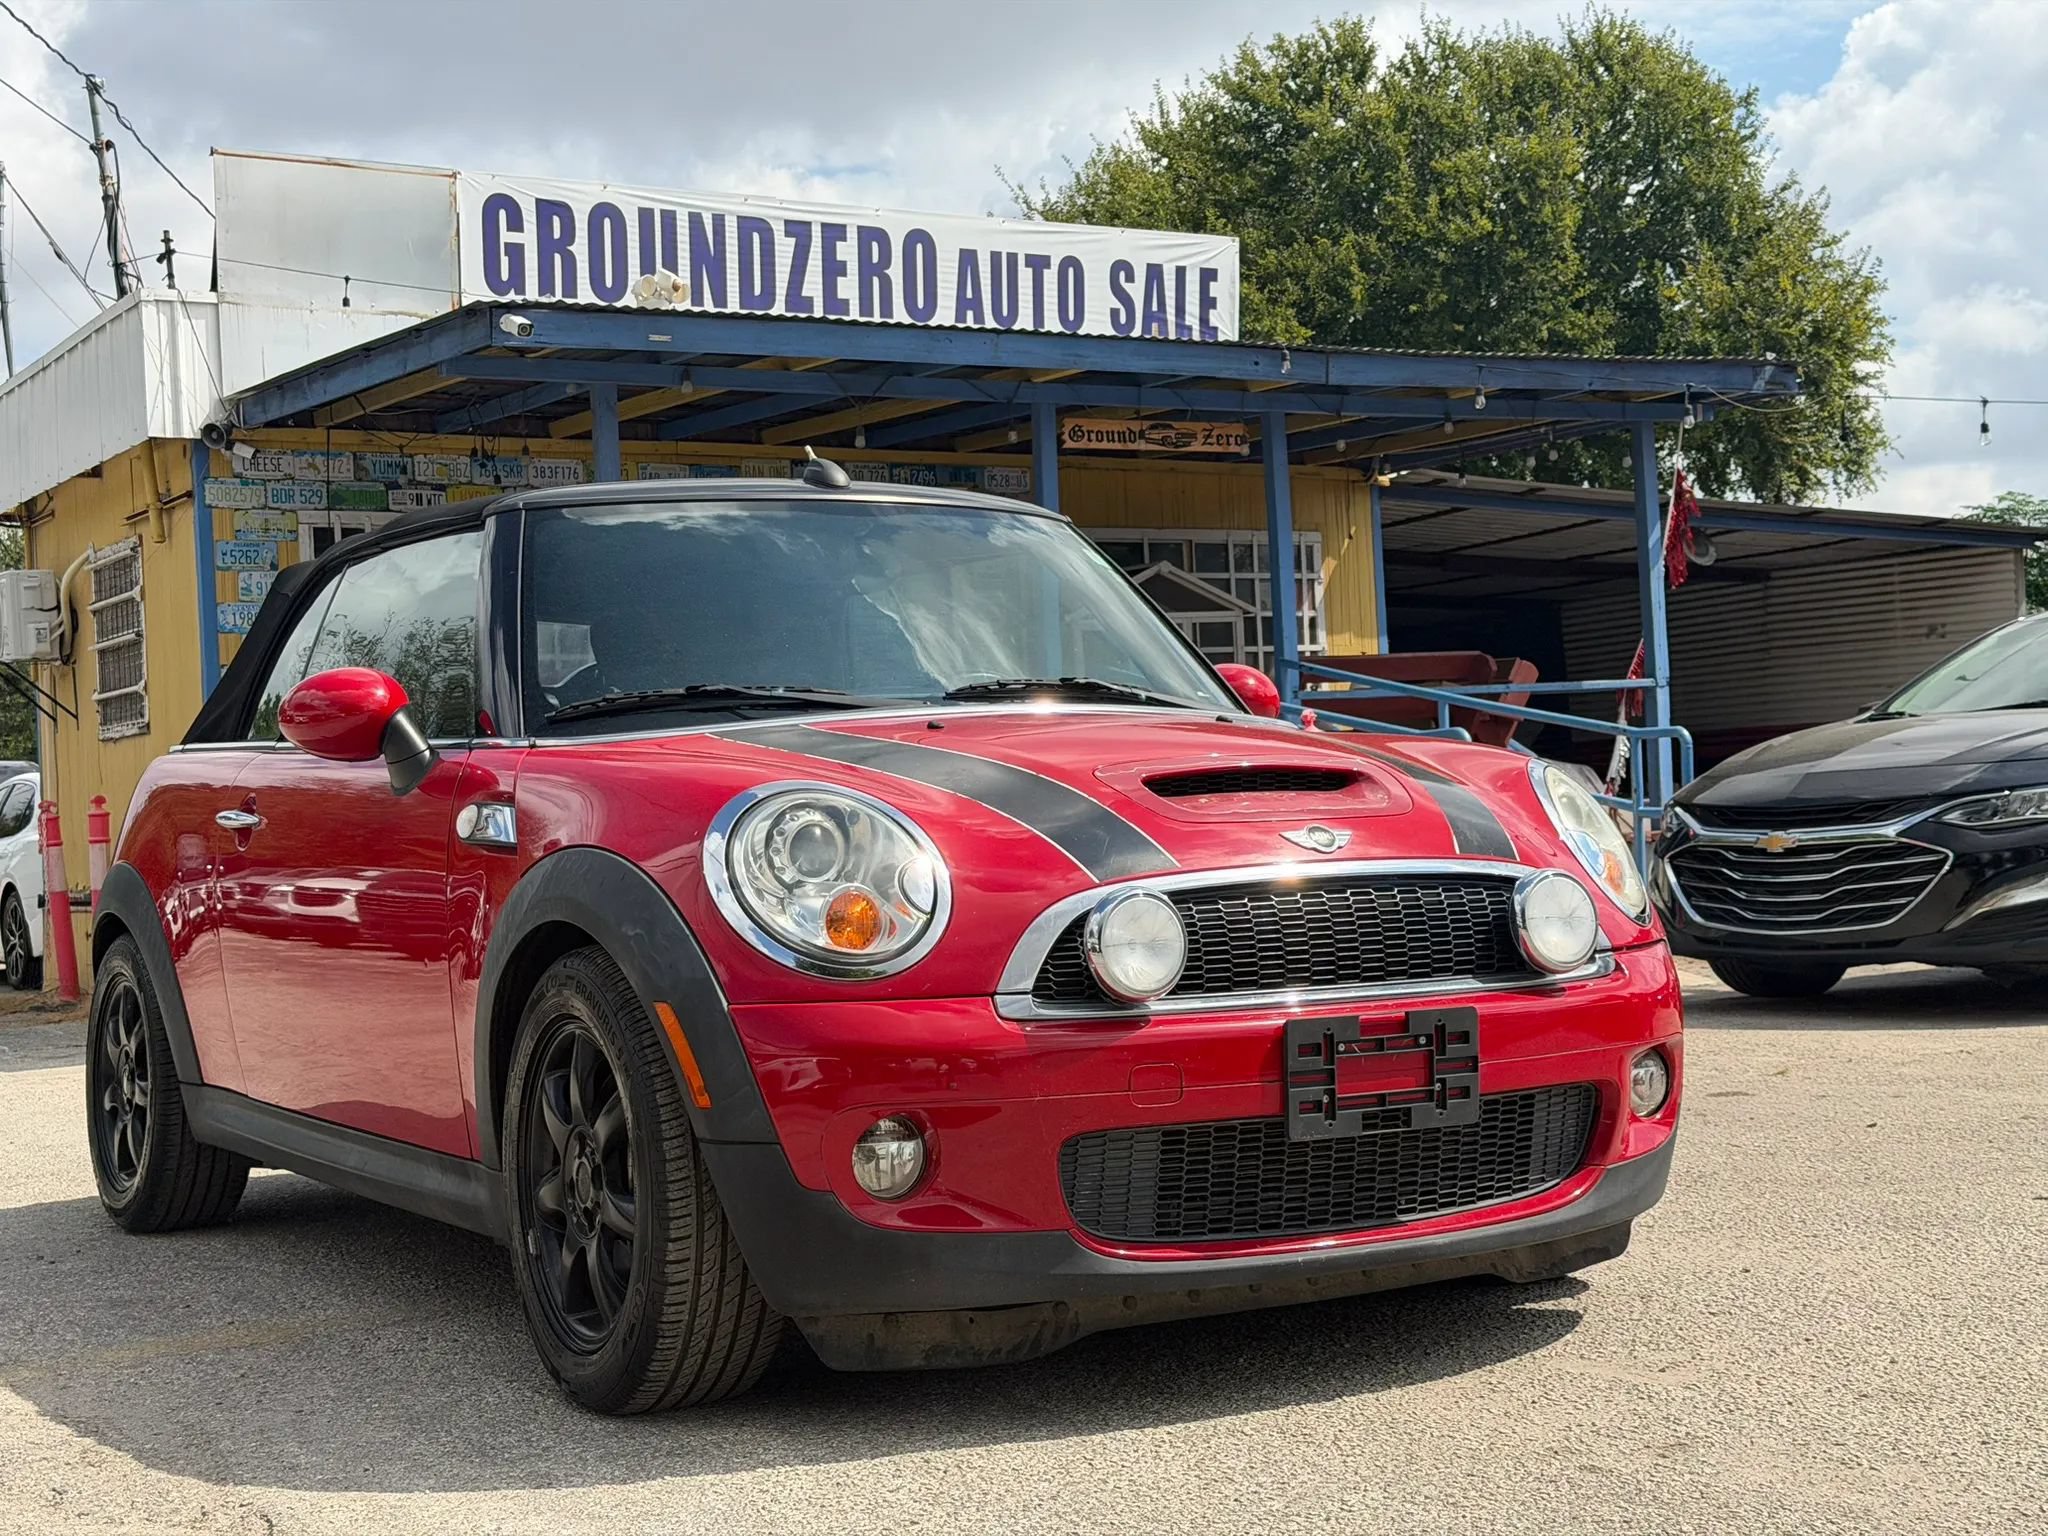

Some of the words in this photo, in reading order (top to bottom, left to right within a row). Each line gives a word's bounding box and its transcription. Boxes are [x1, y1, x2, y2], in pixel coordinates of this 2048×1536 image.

[480, 192, 938, 323] GROUNDZERO
[955, 247, 1085, 332] AUTO
[1109, 258, 1220, 341] SALE
[1068, 424, 1138, 444] Ground
[1201, 424, 1243, 446] Zero
[371, 459, 409, 475] YUMM
[532, 466, 579, 480] 383F176
[299, 488, 323, 505] 529
[230, 549, 260, 565] 5262
[232, 611, 257, 626] 198
[575, 981, 618, 1046] BRAVURIS
